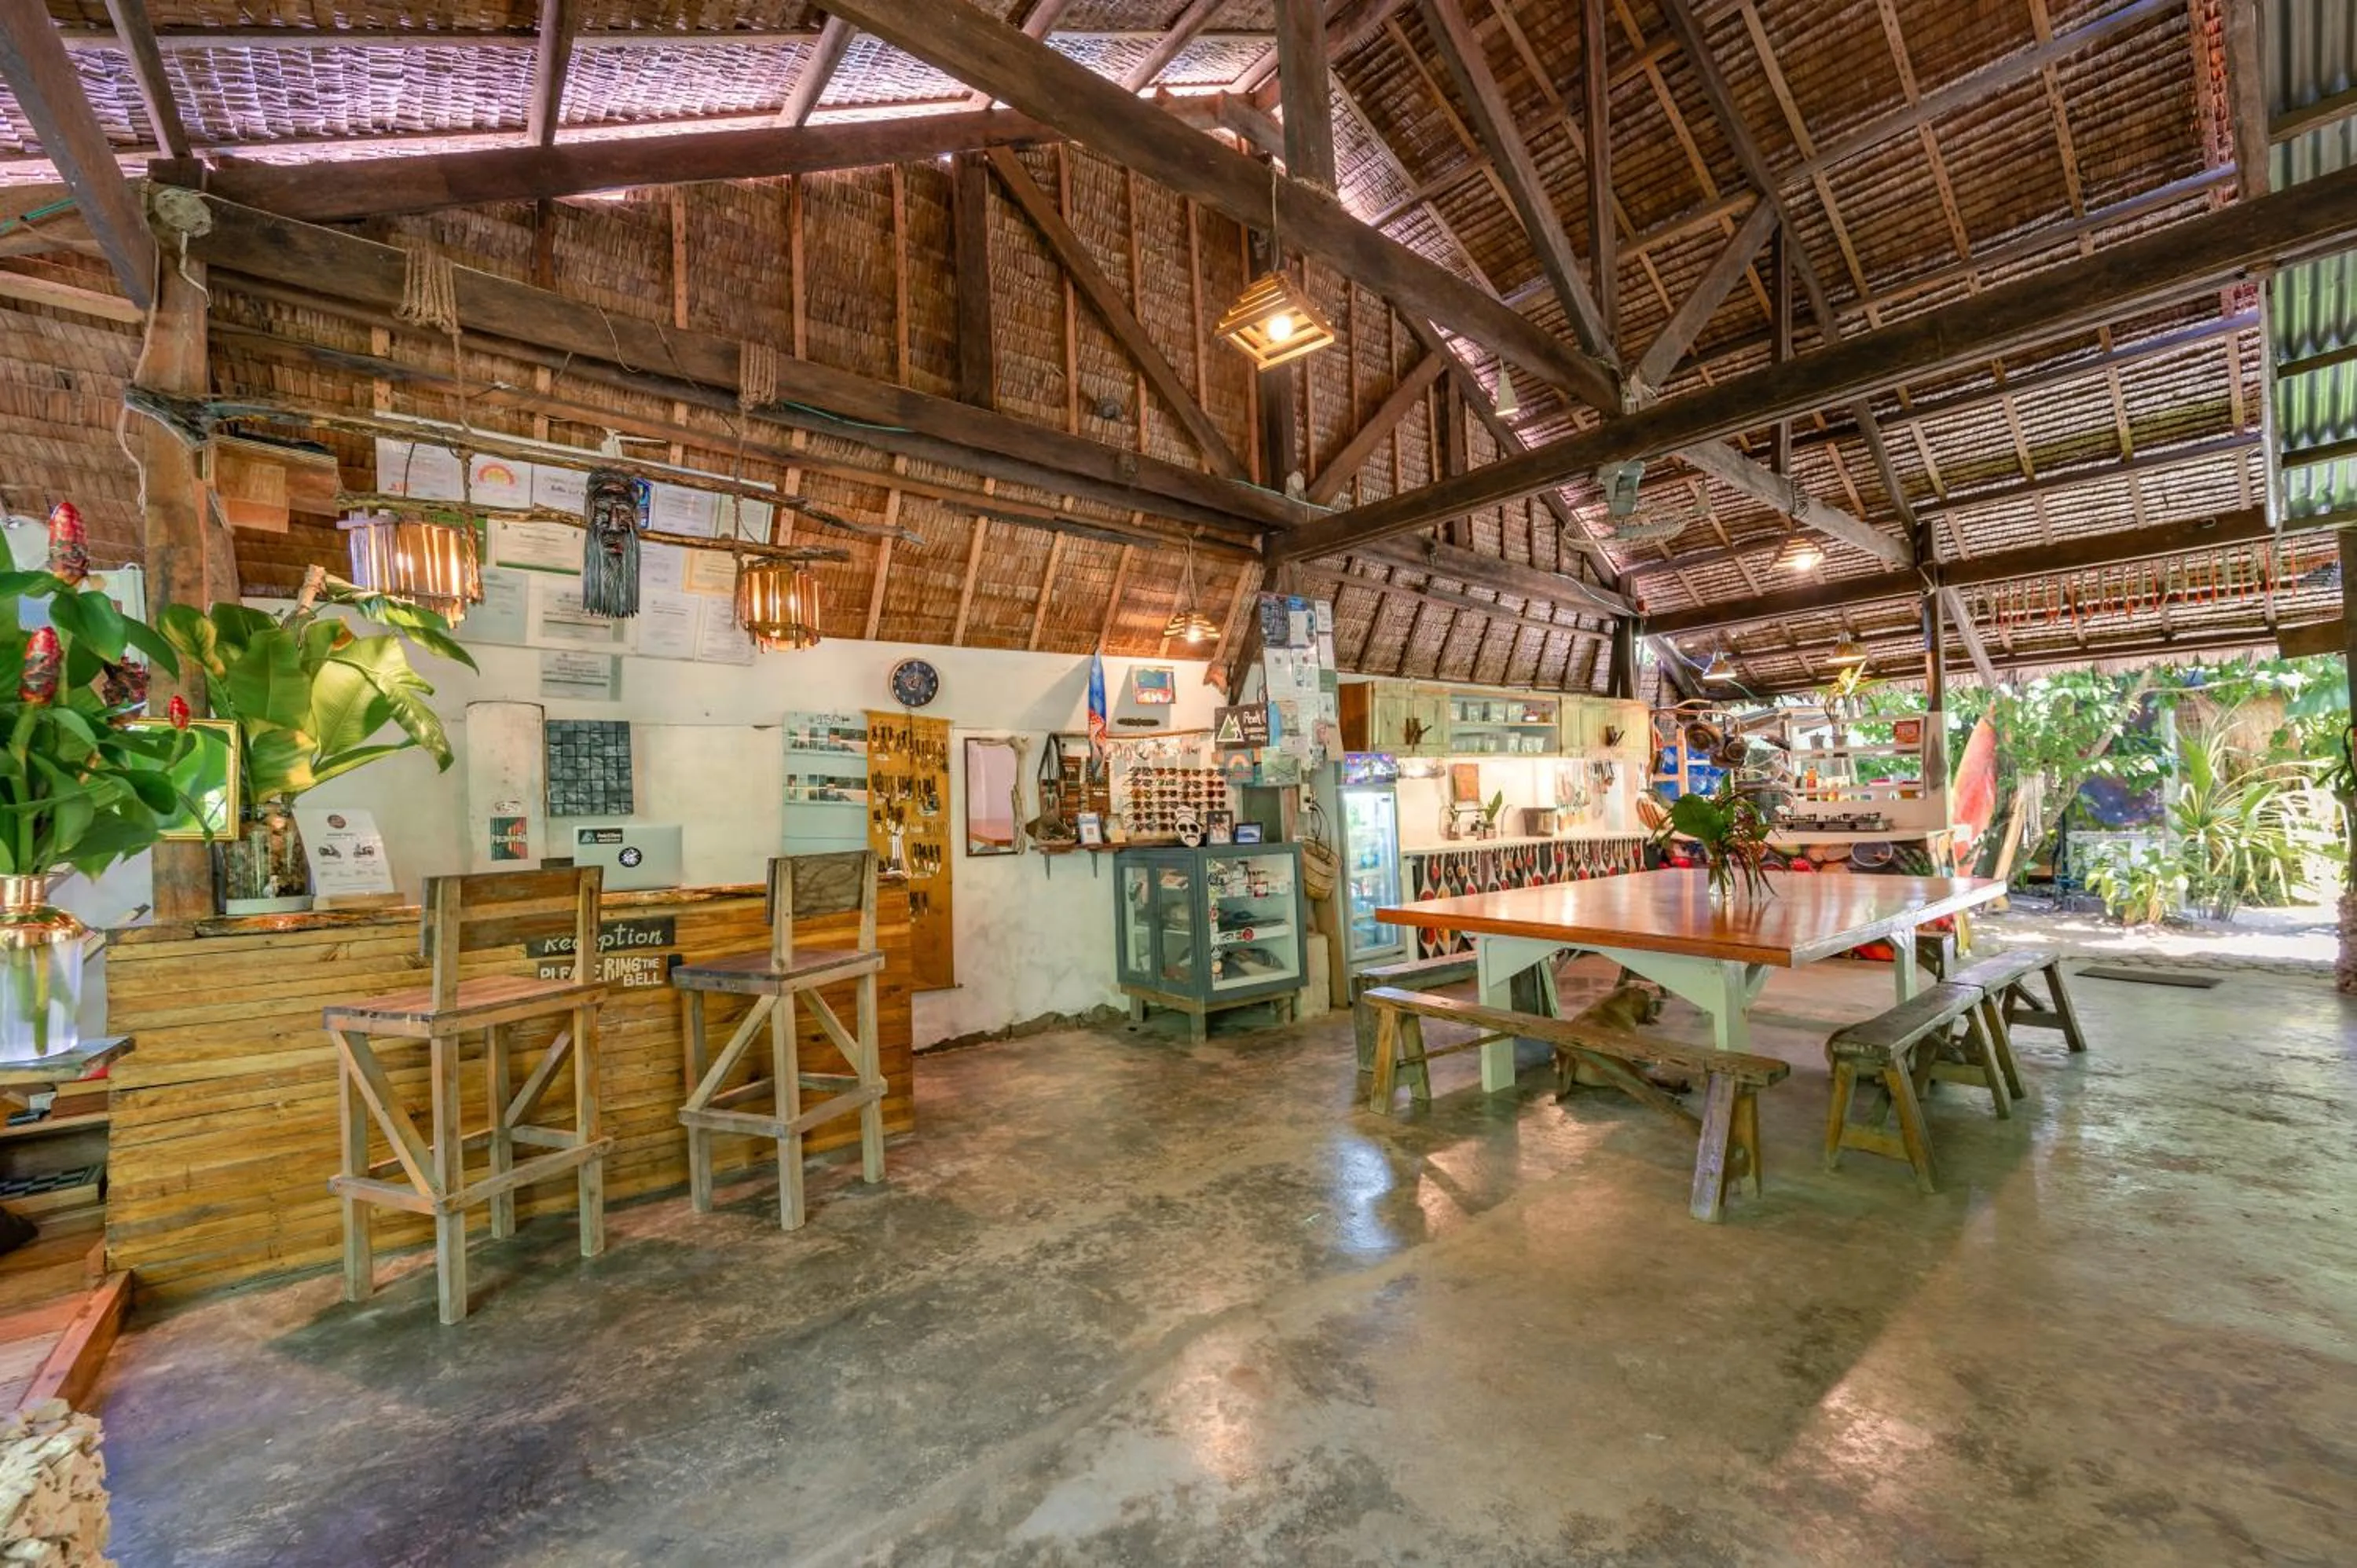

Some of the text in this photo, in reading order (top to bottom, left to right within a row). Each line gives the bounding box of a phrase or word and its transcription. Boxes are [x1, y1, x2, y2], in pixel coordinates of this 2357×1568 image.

[544, 923, 663, 953] Recption
[540, 964, 603, 981] PLE
[603, 957, 641, 981] RING
[623, 969, 663, 987] BELL
